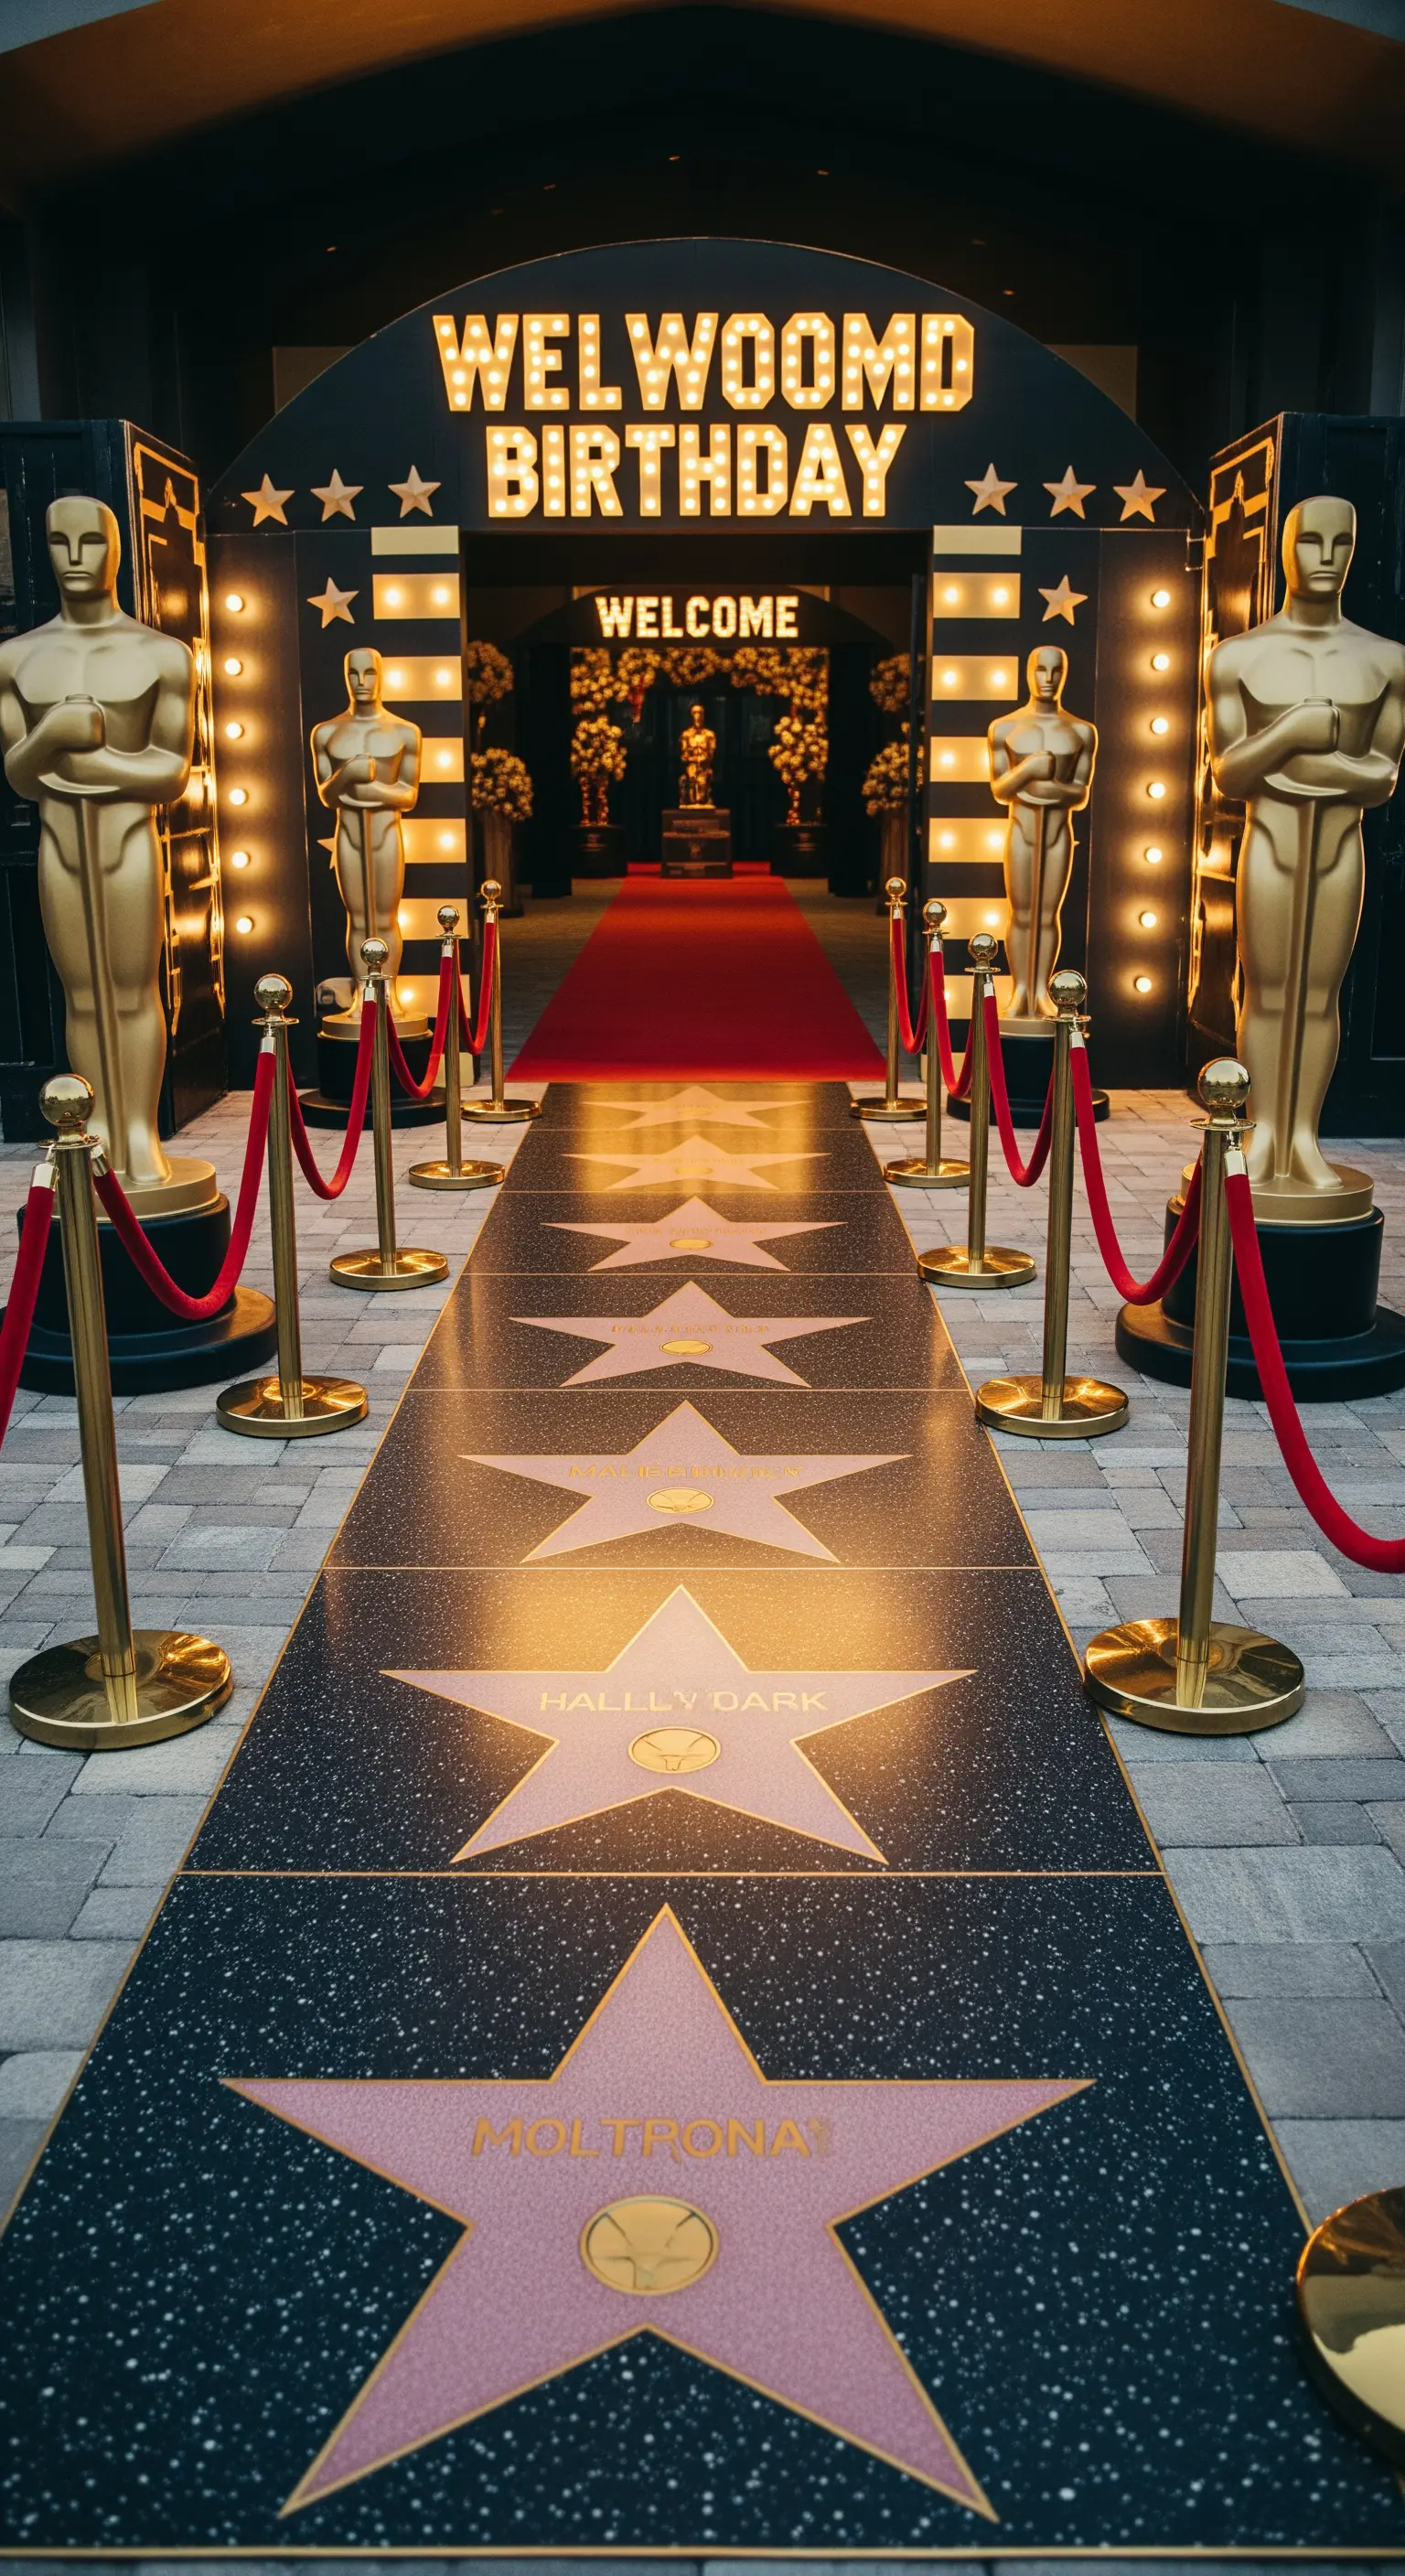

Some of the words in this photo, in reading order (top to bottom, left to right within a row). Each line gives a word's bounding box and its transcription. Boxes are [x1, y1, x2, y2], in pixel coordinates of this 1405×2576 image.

[432, 311, 975, 412] WELWOOMD
[486, 424, 906, 518] BIRTHDAY
[595, 596, 799, 638] WELCOME
